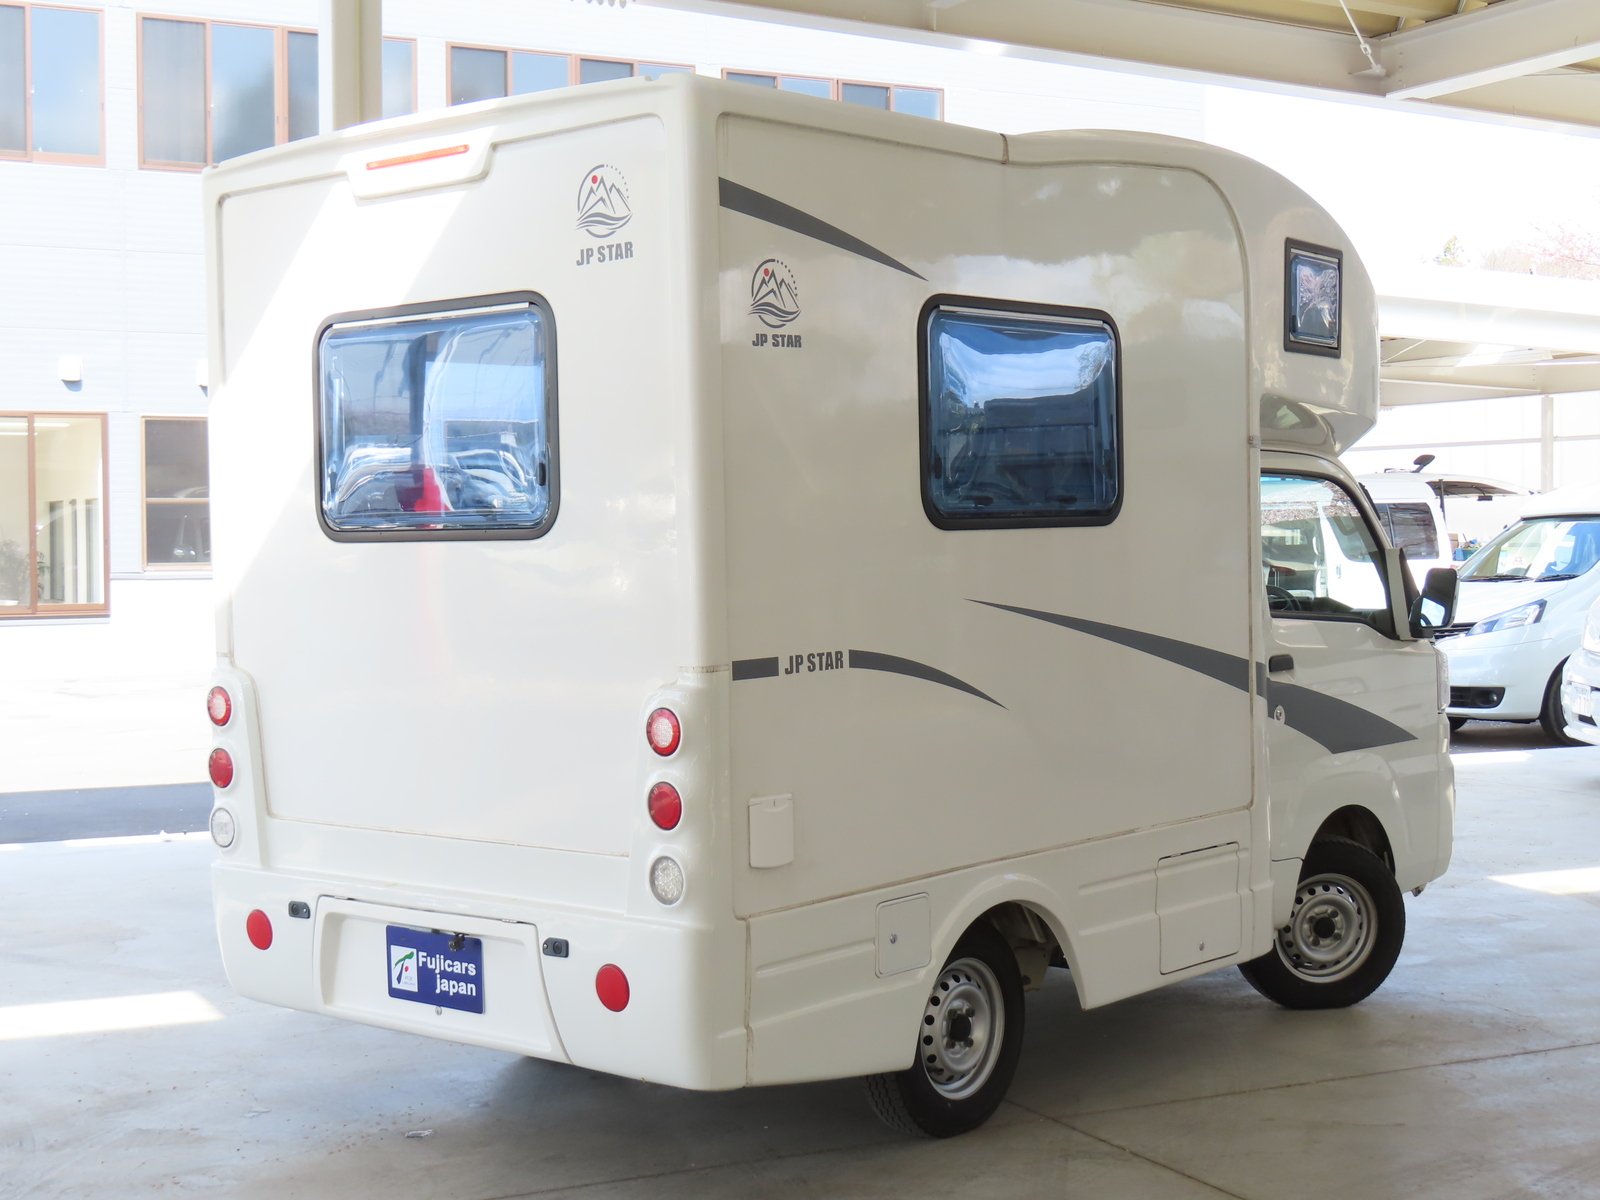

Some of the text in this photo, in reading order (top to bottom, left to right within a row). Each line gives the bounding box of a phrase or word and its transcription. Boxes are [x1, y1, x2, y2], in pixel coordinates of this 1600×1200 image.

[576, 241, 634, 266] JP STAR
[752, 333, 802, 348] JP STAR
[784, 650, 844, 675] JP STAR
[418, 951, 476, 976] Fujicars
[435, 974, 477, 996] japan
